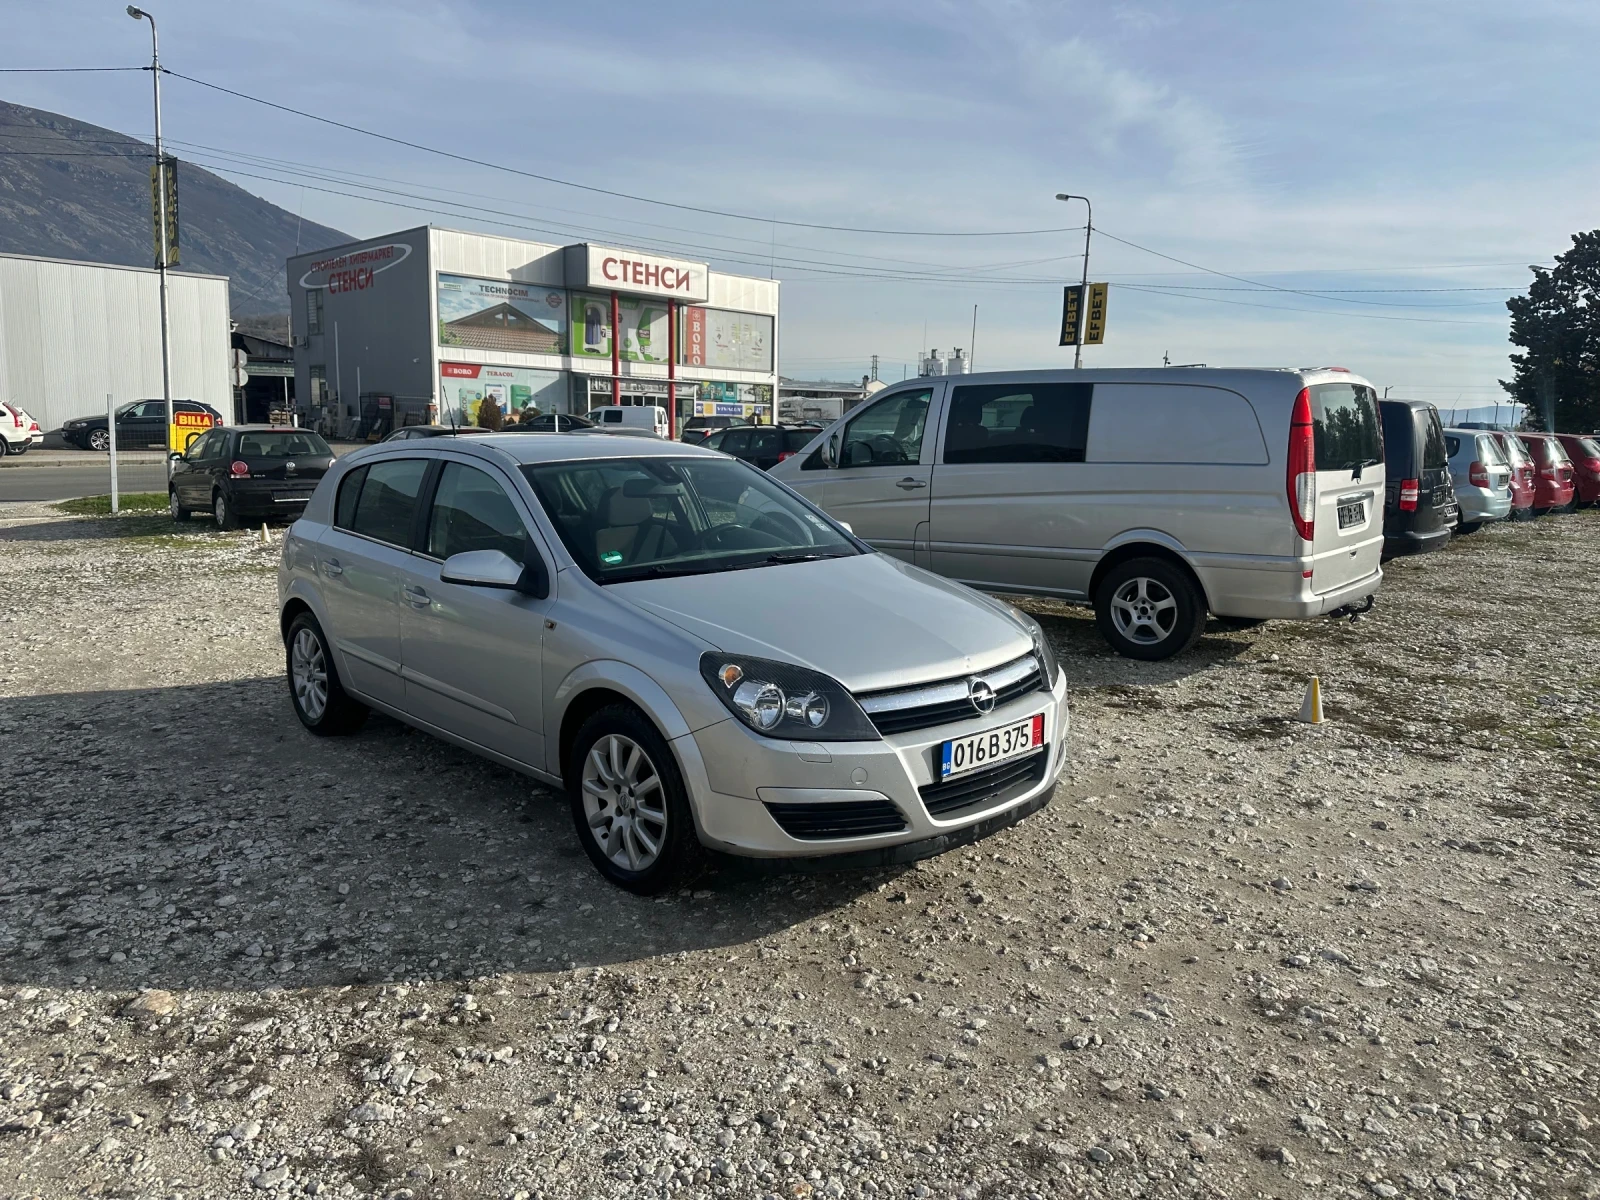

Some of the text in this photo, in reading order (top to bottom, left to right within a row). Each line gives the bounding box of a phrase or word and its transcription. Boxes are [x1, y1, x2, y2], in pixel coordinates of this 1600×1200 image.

[310, 246, 395, 273] СТРОИТЕЛЕН ХИПЕРМАРКЕТ
[328, 267, 374, 294] СТЕНСИ
[602, 257, 690, 291] СТЕНСИ
[479, 284, 528, 297] TECHNOCIM
[1064, 290, 1078, 343] EFBET
[1089, 288, 1103, 341] EFBET
[692, 321, 701, 365] BORO
[453, 367, 514, 378] BORO TERACOL
[179, 415, 211, 427] BILLA
[942, 762, 951, 771] BG
